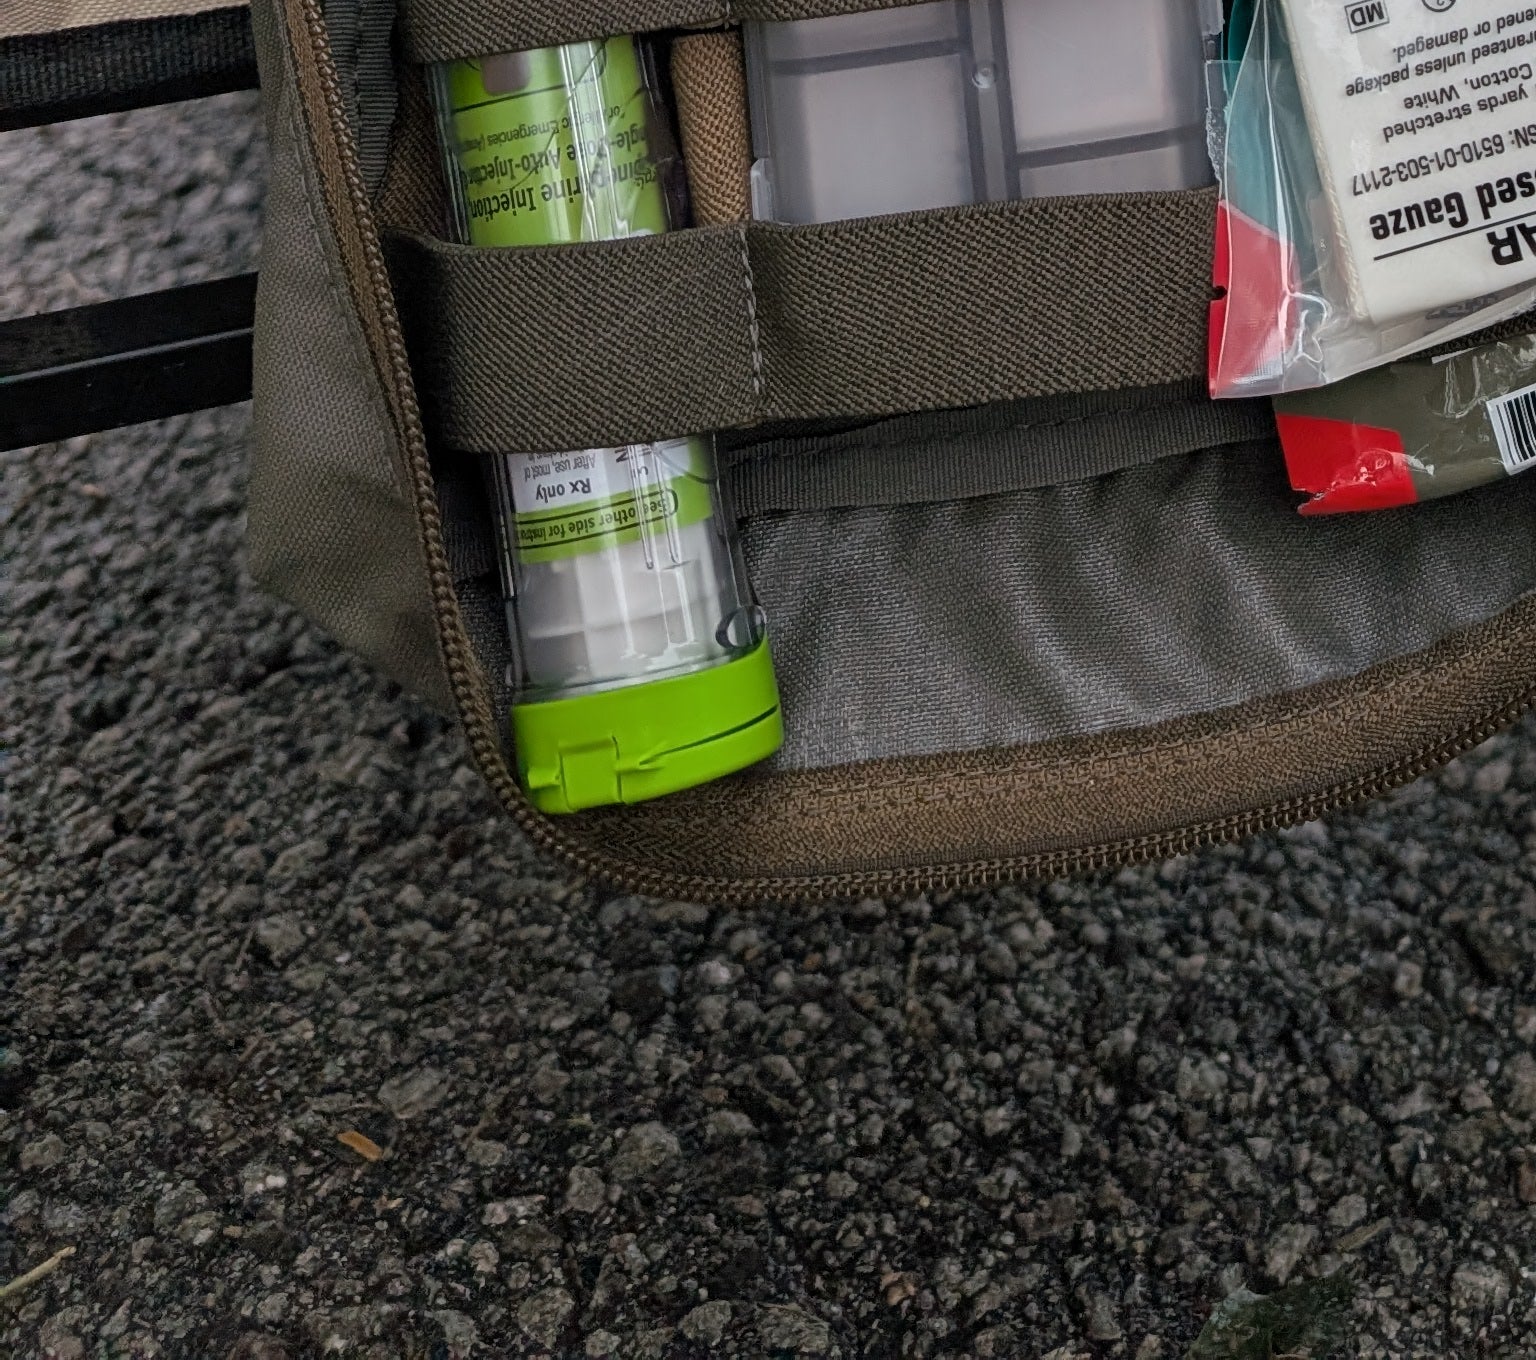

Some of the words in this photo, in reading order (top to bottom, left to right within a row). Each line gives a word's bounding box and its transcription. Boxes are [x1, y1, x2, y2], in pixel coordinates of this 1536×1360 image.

[1350, 1, 1386, 27] MD
[1473, 18, 1491, 35] or
[1392, 26, 1469, 63] damaged.
[1415, 49, 1466, 78] unless
[1463, 62, 1533, 90] Cotton,
[1345, 63, 1410, 97] package
[1403, 83, 1460, 110] White
[1477, 86, 1528, 113] yards
[1382, 103, 1472, 144] stretched
[1352, 133, 1505, 197] 6510-01-503-2117
[1369, 191, 1470, 240] Gauze
[535, 483, 565, 504] only
[568, 478, 592, 495] Rx
[547, 523, 566, 539] for
[568, 516, 595, 534] side
[599, 507, 636, 528] other
